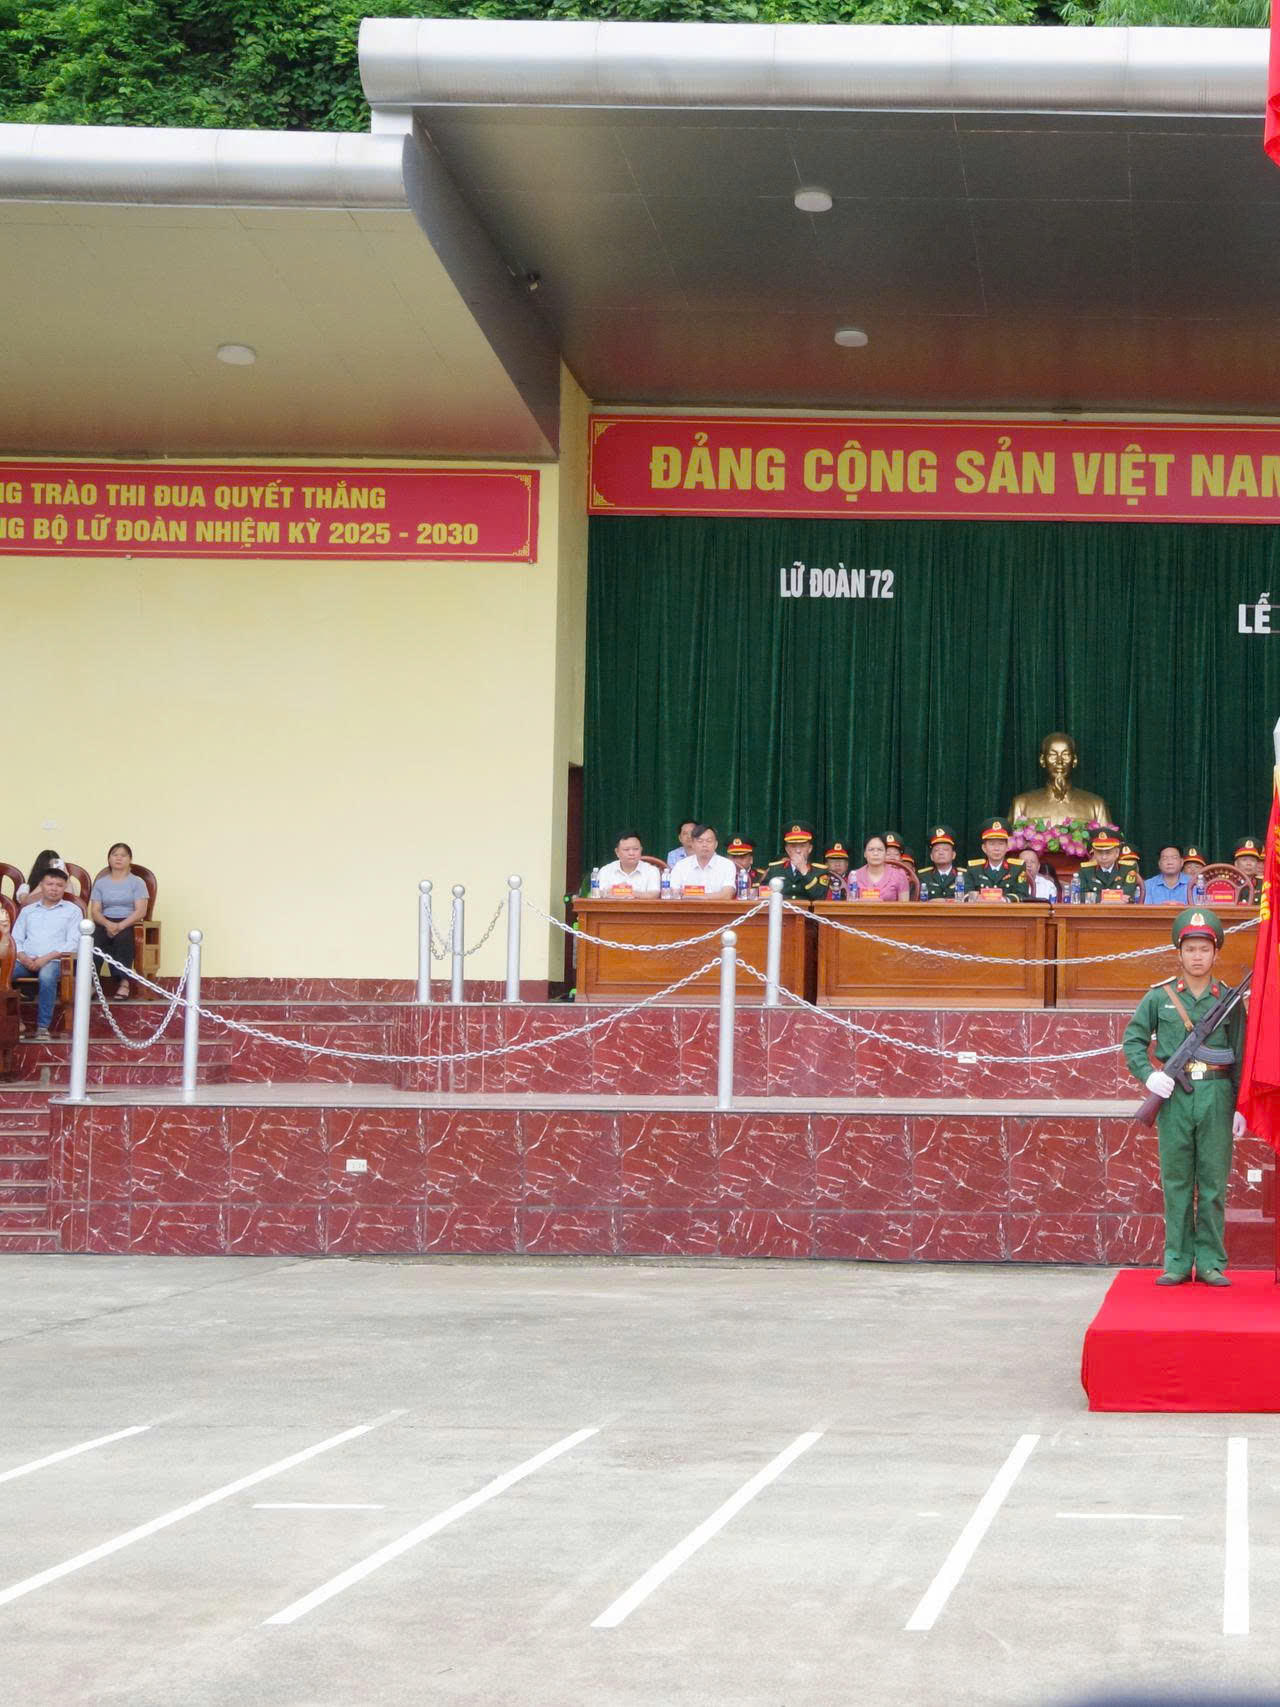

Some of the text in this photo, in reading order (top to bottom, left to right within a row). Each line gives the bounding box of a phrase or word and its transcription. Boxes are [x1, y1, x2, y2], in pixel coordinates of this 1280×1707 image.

[649, 431, 786, 491] ĐẢNG
[803, 439, 938, 502] CỘNG
[954, 436, 1056, 495] SẢN
[1071, 443, 1176, 506] VIỆT
[0, 482, 23, 504] G
[31, 479, 98, 506] TRÀO
[105, 484, 146, 507] THI
[153, 485, 207, 508] ĐUA
[214, 479, 295, 510] QUYẾT
[32, 513, 69, 545] BỘ
[76, 513, 112, 542] LỮ
[114, 515, 188, 543] ĐOÀN
[195, 516, 281, 549] NHIỆM
[287, 517, 321, 545] KỲ
[328, 521, 392, 545] 2025
[415, 522, 479, 545] 2030
[780, 561, 894, 599] LỮ ĐOÀN 72
[1238, 592, 1272, 634] LỄ
